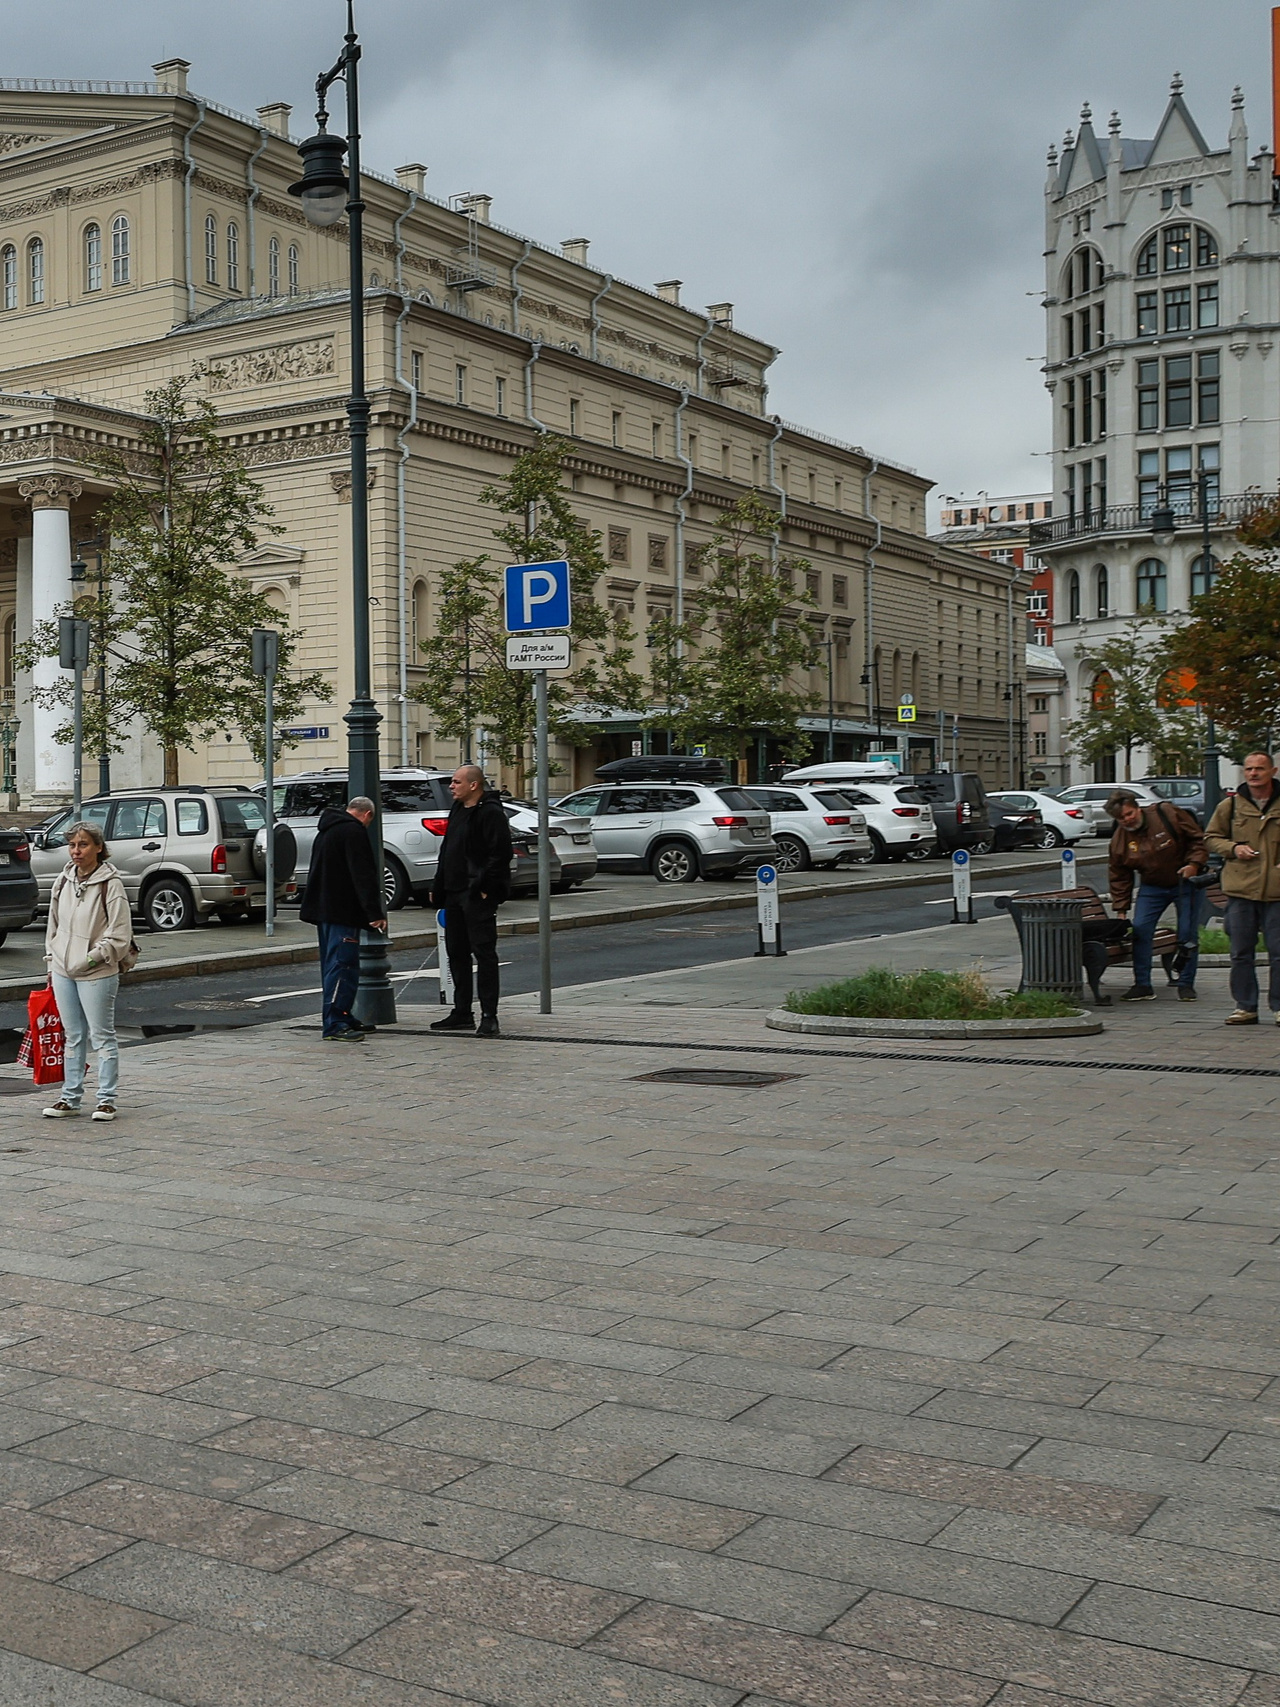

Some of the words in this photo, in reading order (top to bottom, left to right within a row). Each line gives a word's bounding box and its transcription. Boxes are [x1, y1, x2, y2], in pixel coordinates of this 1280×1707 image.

[523, 570, 558, 624] P
[520, 644, 538, 653] Для
[540, 644, 554, 652] а/м
[510, 654, 532, 663] ГАМТ
[534, 653, 566, 662] России
[321, 728, 326, 736] 1
